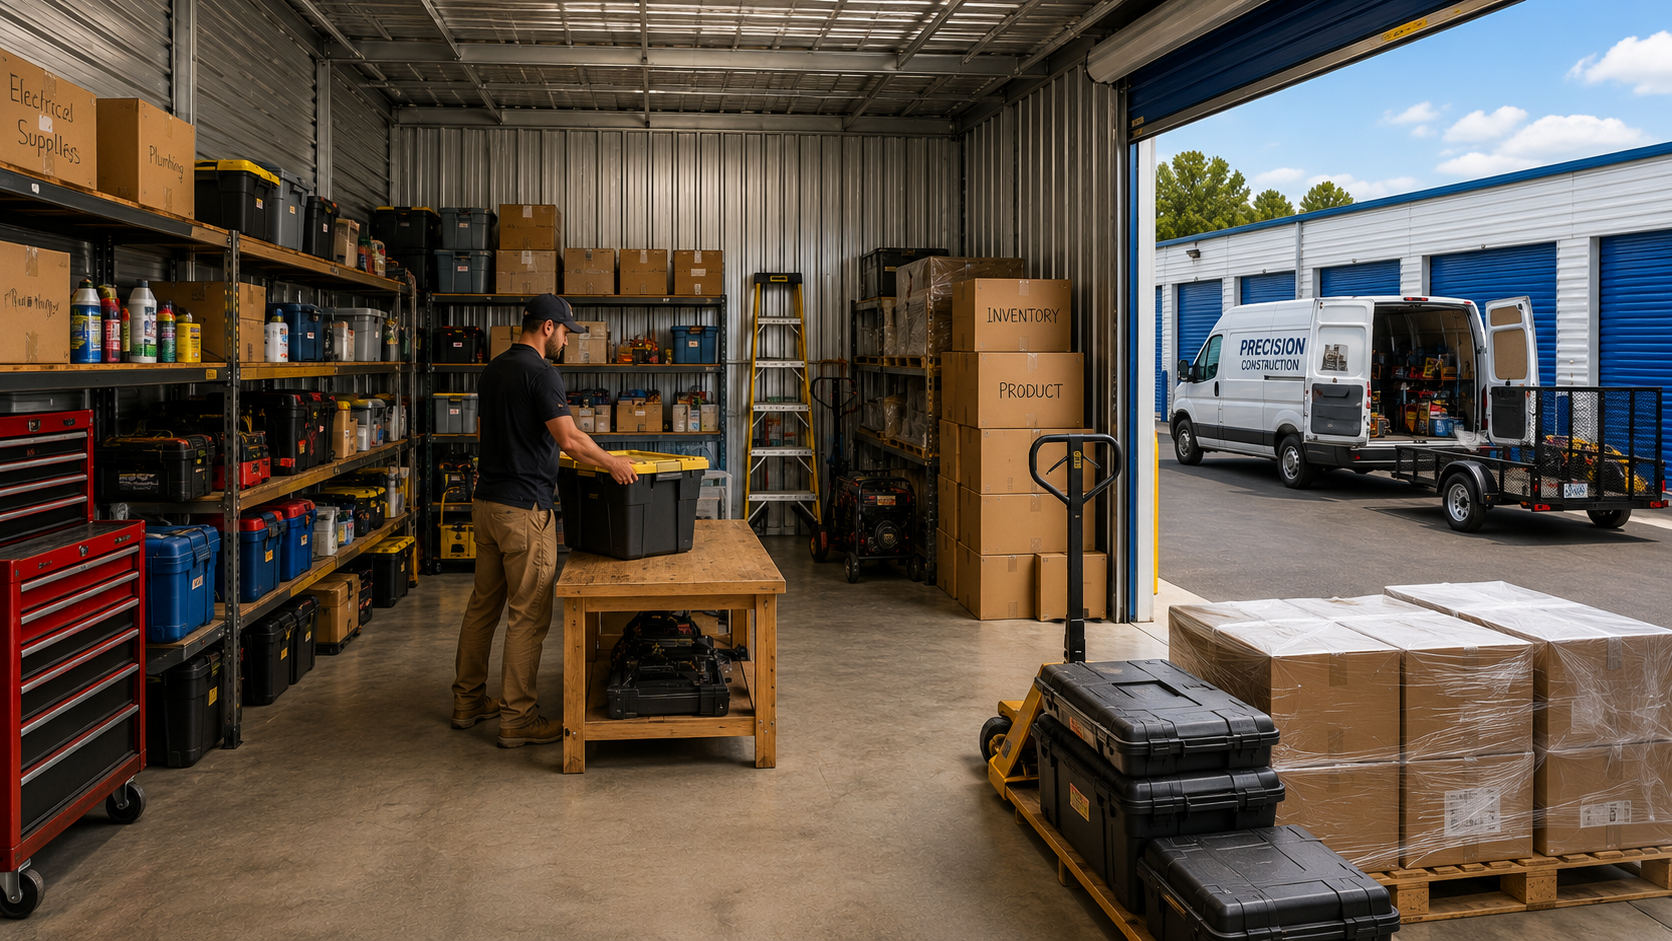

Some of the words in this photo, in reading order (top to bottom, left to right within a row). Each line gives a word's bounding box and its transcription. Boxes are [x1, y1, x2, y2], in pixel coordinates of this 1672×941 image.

[10, 72, 74, 123] Electrical
[987, 307, 1060, 324] INVENTORY
[1239, 337, 1306, 356] PRECISION
[1241, 359, 1300, 371] CONSTRUCTION
[999, 381, 1064, 399] PRODUCT
